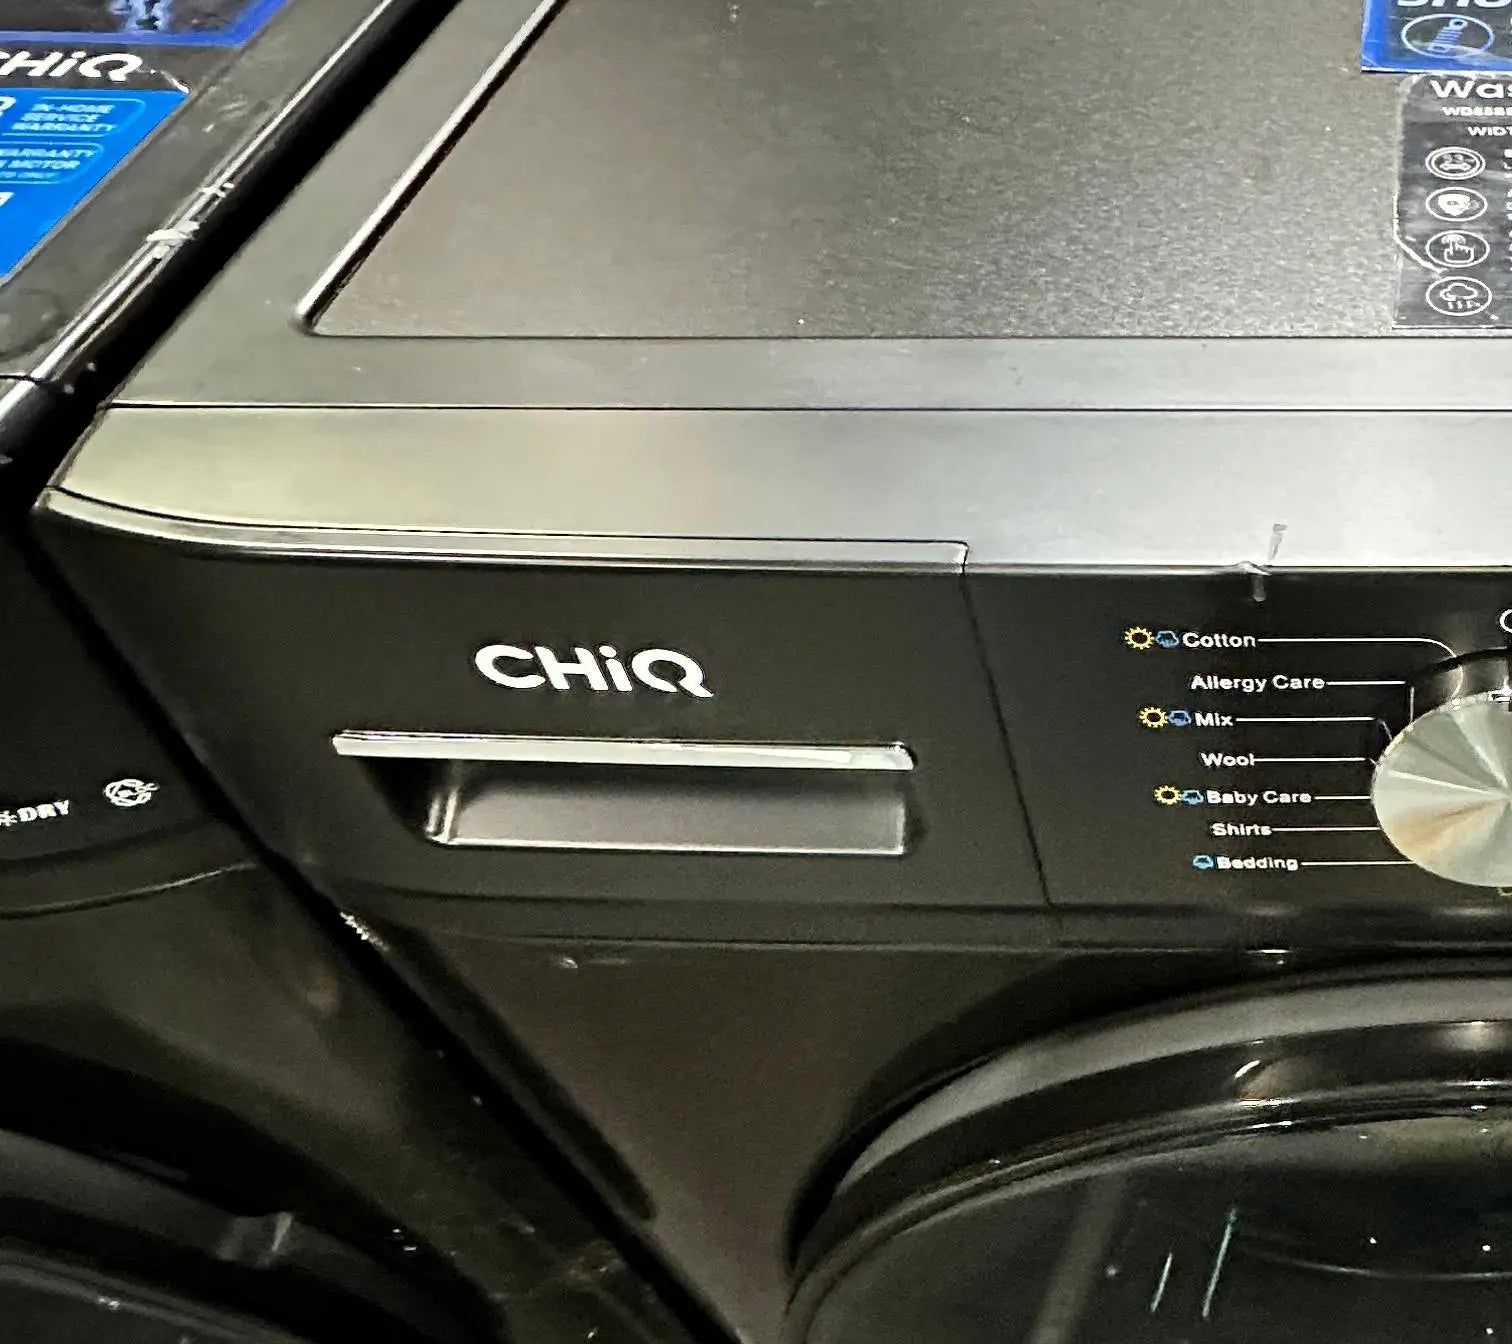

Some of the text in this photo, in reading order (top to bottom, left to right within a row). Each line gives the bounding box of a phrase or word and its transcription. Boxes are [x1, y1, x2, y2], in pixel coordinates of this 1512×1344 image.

[0, 50, 143, 82] HiQ
[1182, 632, 1256, 649] Cotton
[475, 645, 714, 698] CHiQ
[1191, 675, 1325, 693] Allergy Care
[1195, 712, 1234, 727] Mix
[1201, 752, 1255, 767] Wool
[1206, 790, 1312, 806] Baby Care
[1211, 822, 1272, 836] Shirts
[1216, 856, 1298, 871] Bedding
